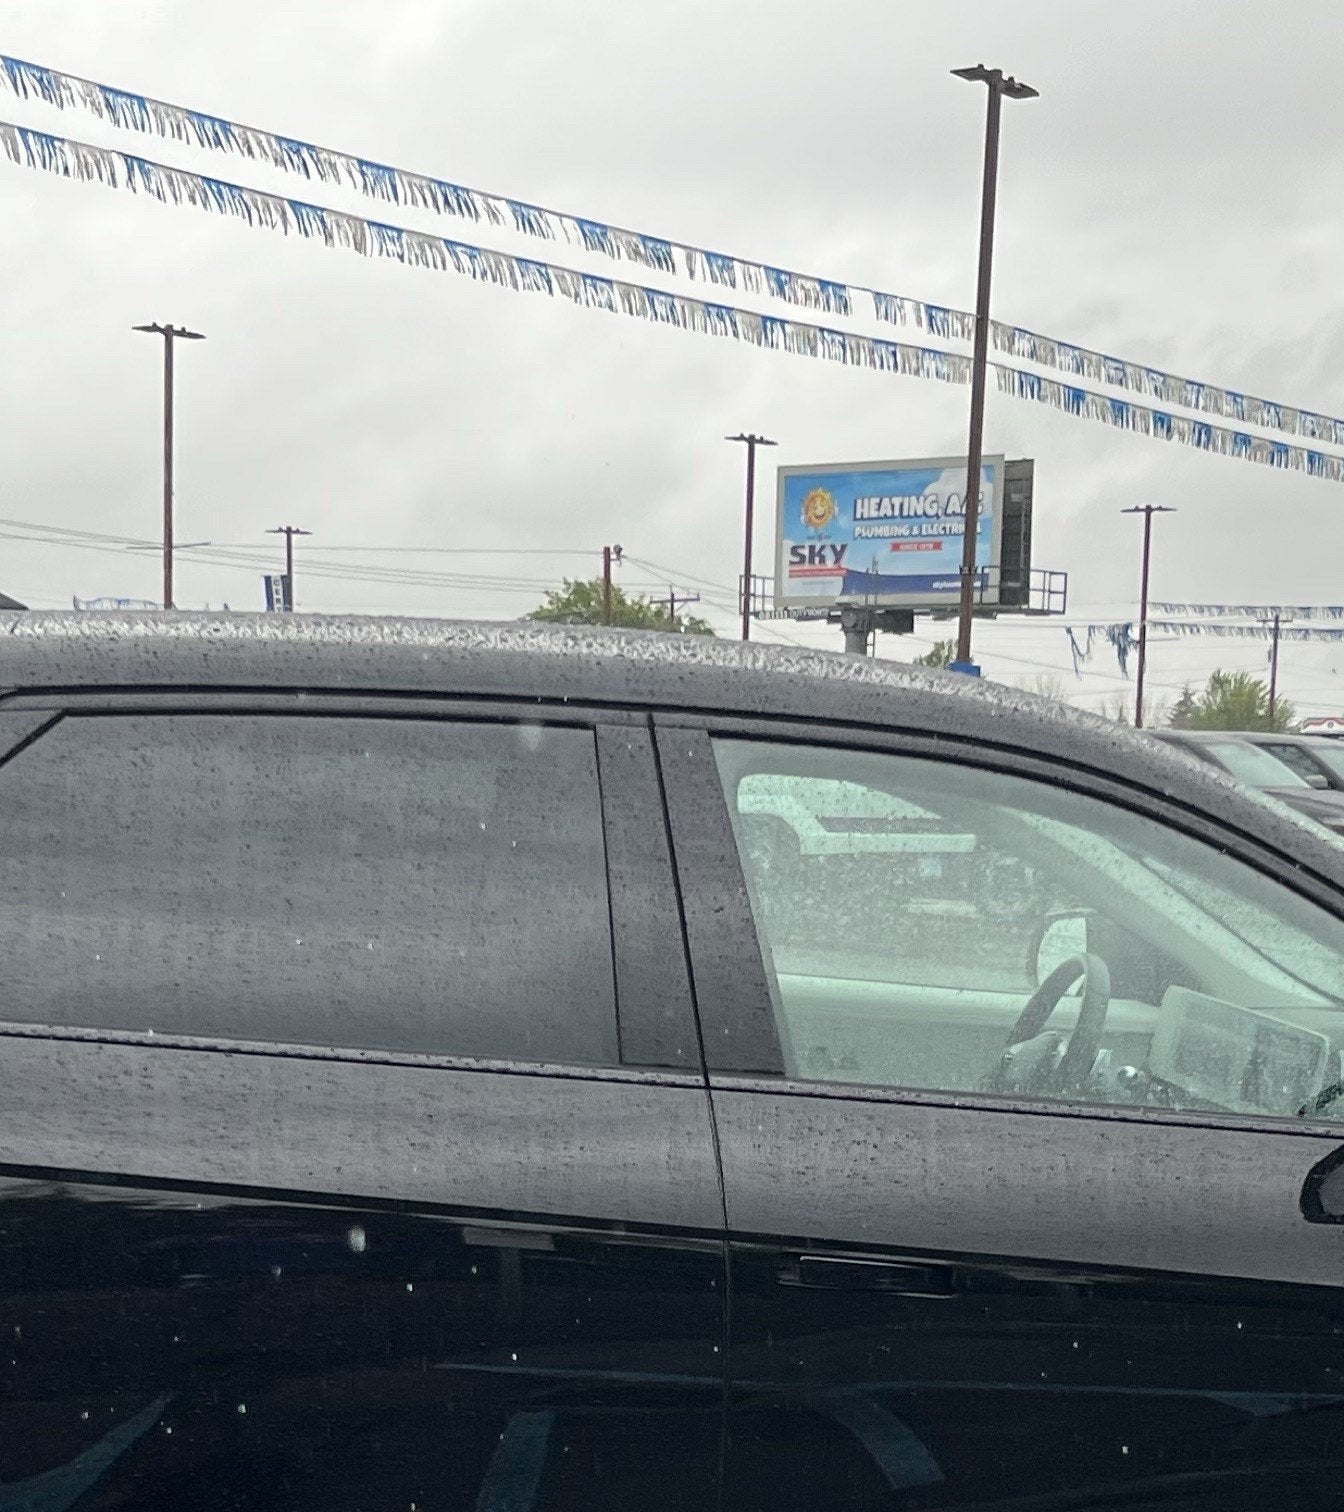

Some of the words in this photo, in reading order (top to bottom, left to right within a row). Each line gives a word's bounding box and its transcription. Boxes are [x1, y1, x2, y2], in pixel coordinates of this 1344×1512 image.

[854, 494, 943, 520] HEATING,
[854, 523, 911, 538] PLUMBING
[921, 521, 983, 537] ELECTRIL
[788, 543, 848, 566] SKY
